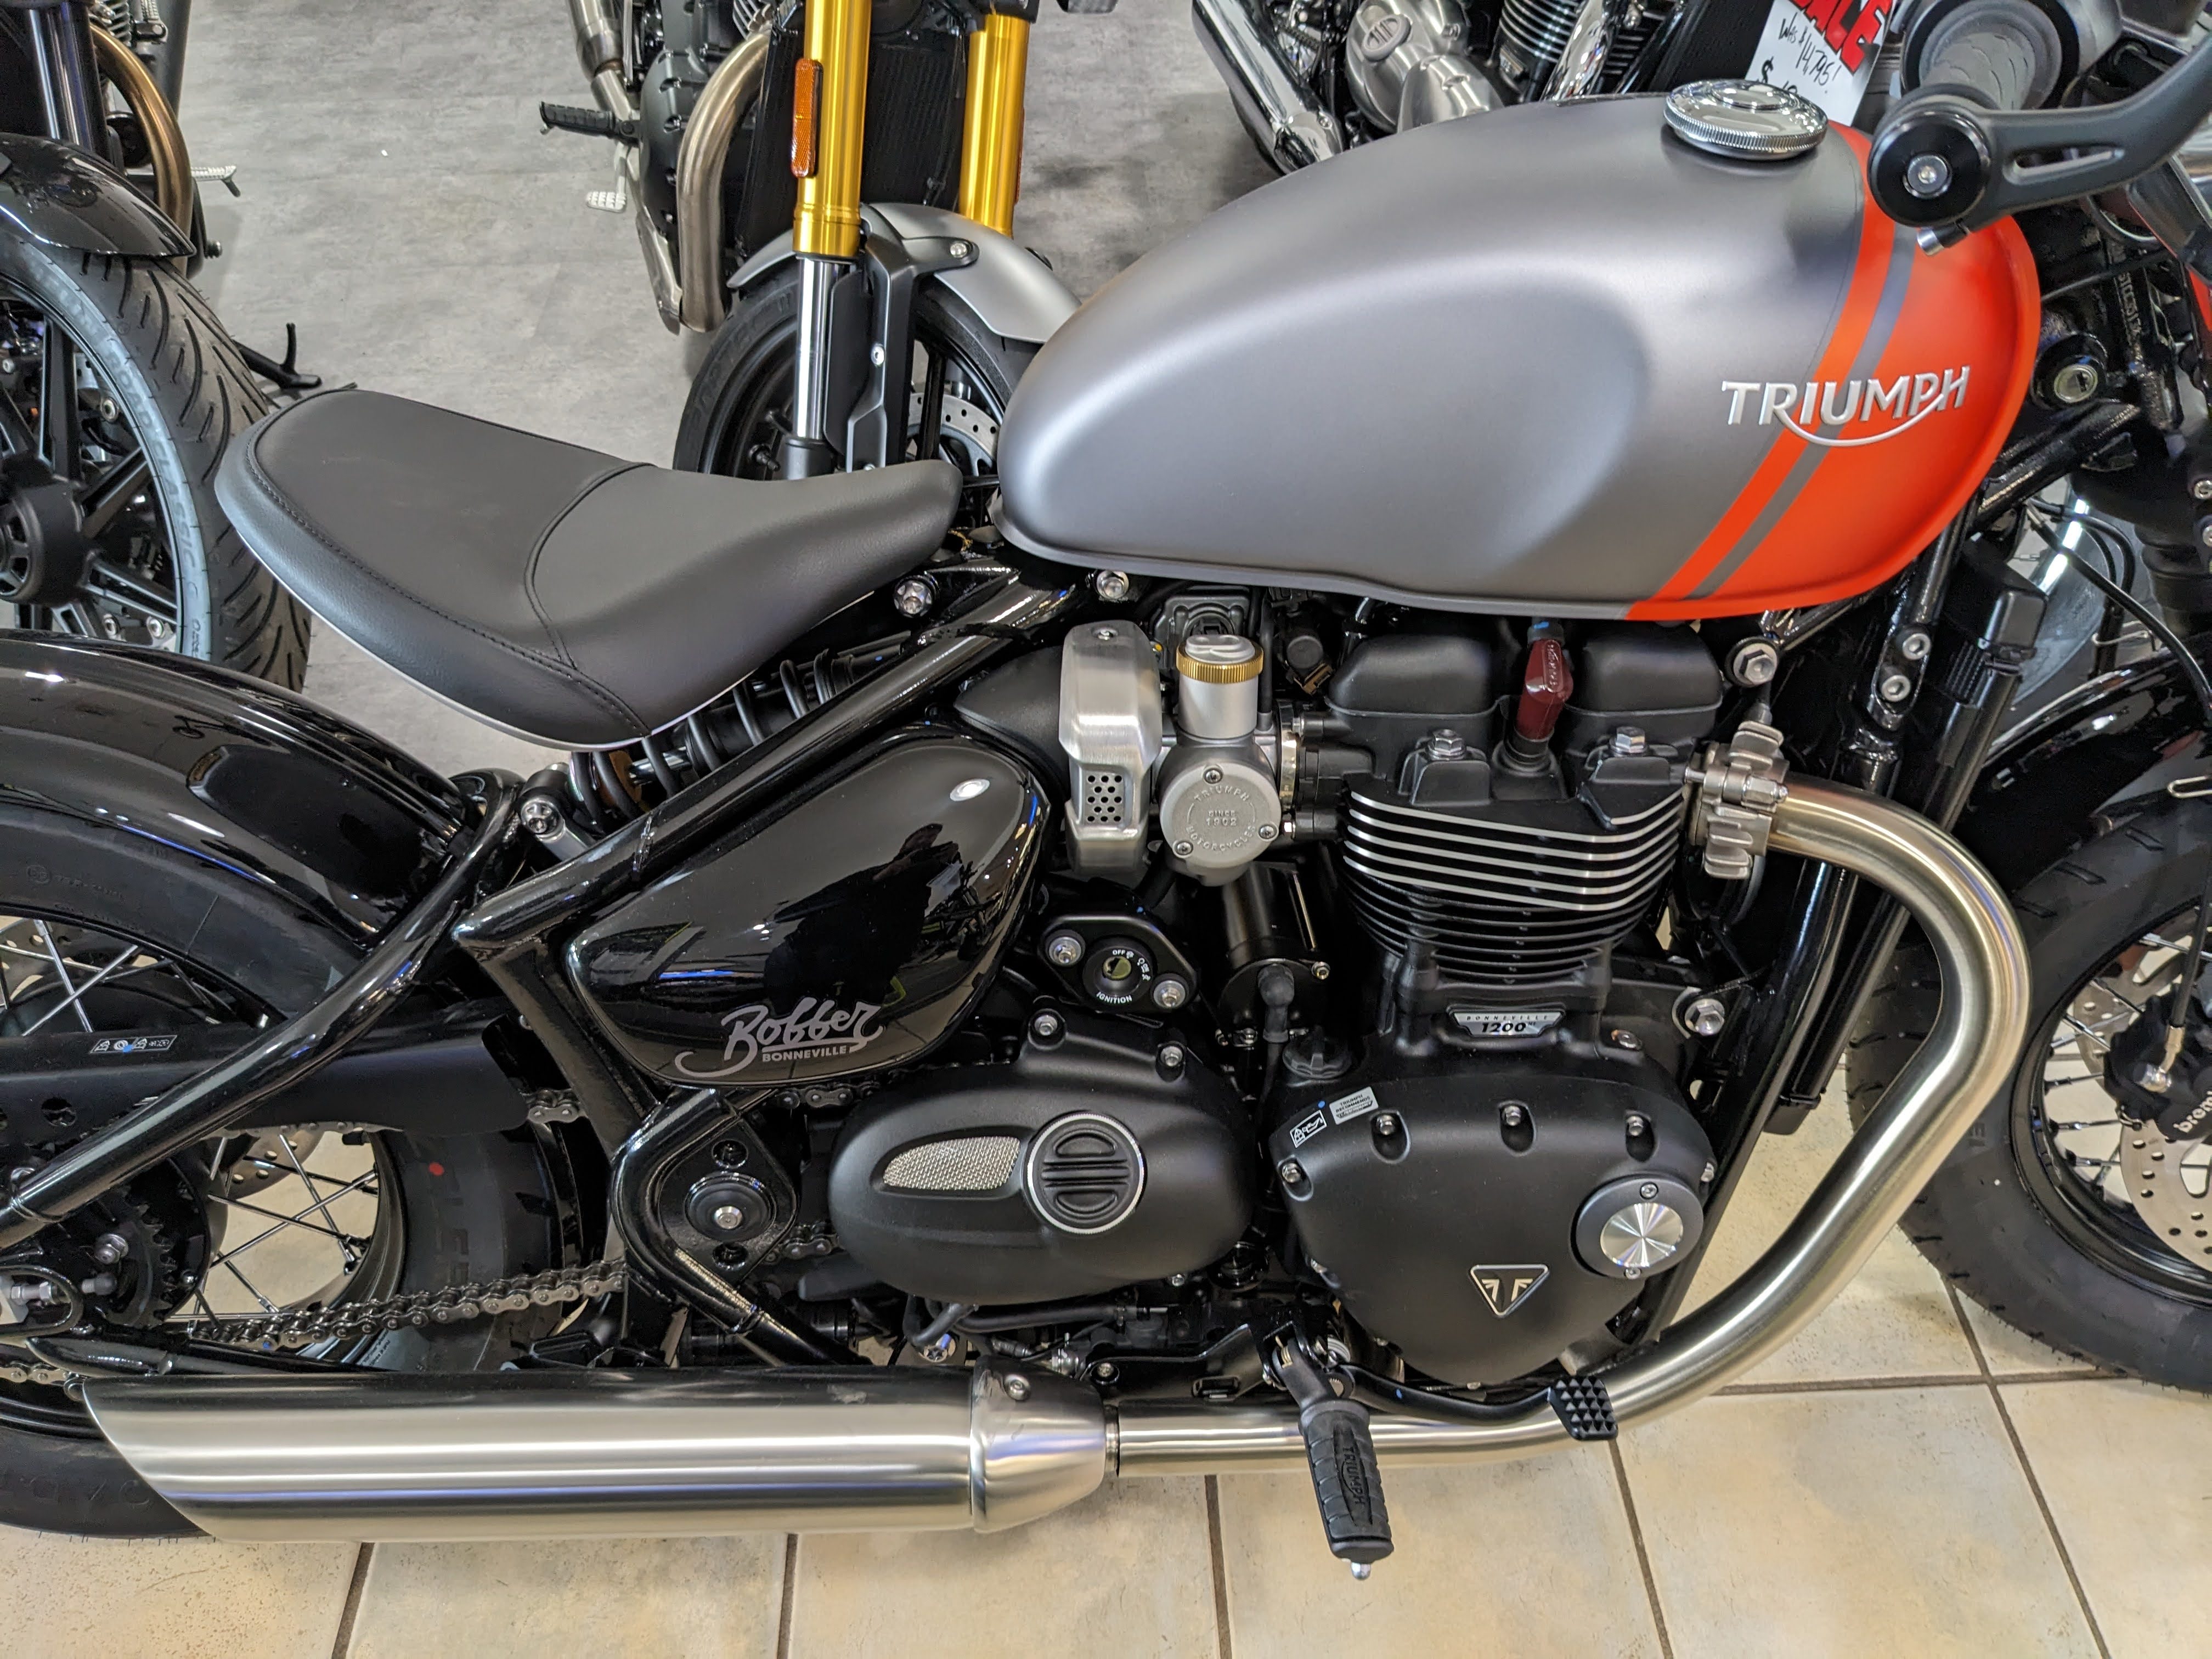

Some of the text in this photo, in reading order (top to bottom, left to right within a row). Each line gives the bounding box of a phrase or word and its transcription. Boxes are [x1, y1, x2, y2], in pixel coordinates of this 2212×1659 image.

[1787, 0, 1894, 76] LE
[1722, 365, 1971, 447] TRIUMPH
[1193, 785, 1249, 803] TRIUMPH
[1206, 817, 1237, 827] 1902
[1185, 825, 1256, 852] MOTORCYCLES
[1096, 991, 1132, 1005] IGNITION
[674, 996, 886, 1077] Bobber
[1481, 1022, 1526, 1033] 1200
[762, 1045, 847, 1063] BONNEVILLE
[2173, 1091, 2212, 1133] brem
[1341, 1447, 1365, 1505] TRIUMPH
